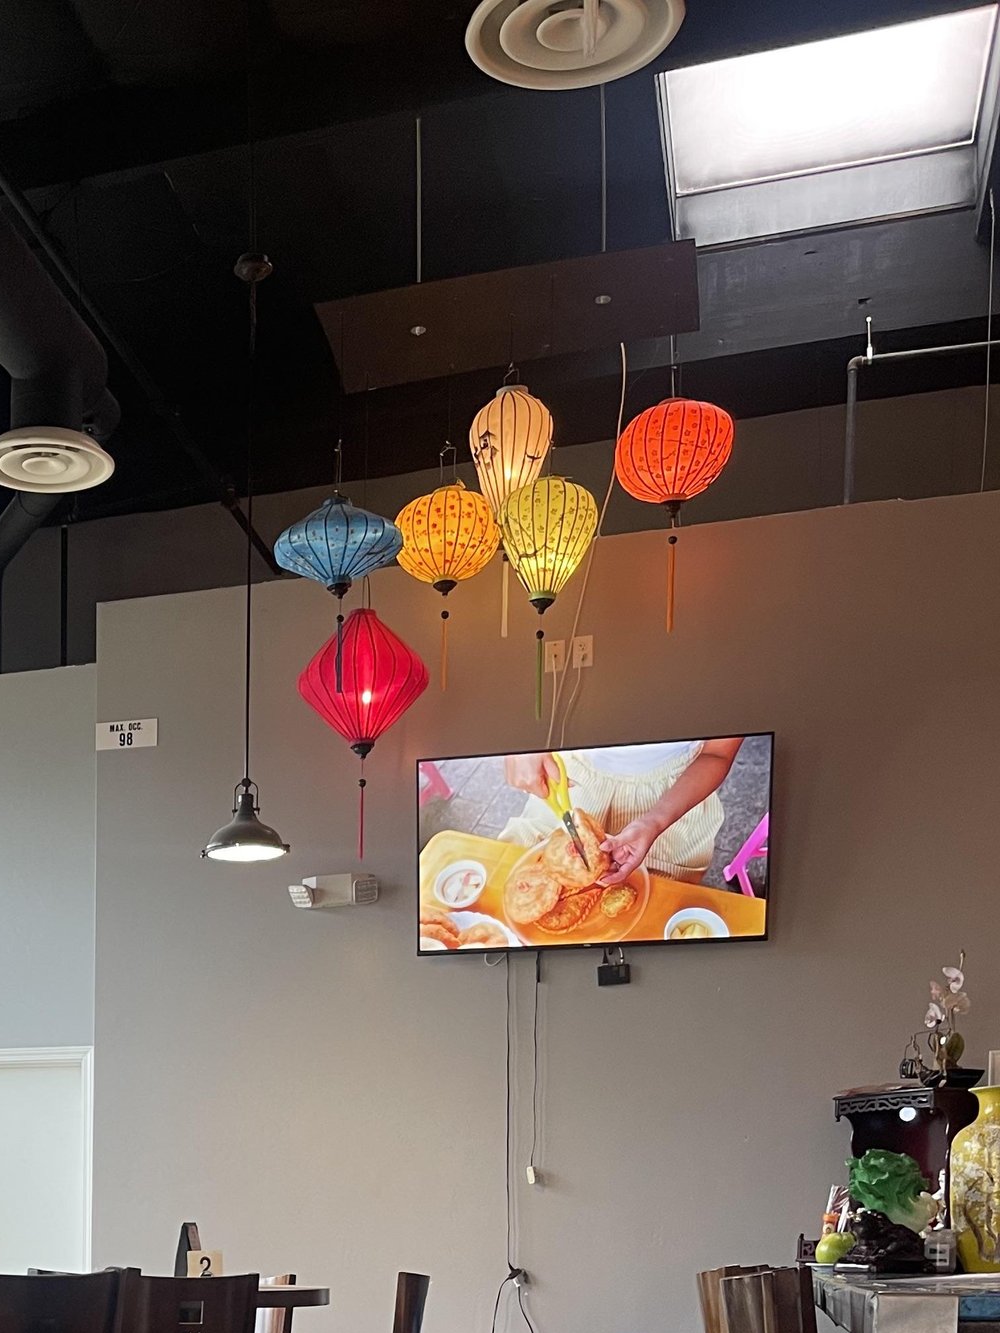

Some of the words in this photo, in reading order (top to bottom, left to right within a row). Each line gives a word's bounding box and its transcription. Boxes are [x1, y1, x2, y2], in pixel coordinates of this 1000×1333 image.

[109, 723, 126, 732] MAX.
[128, 722, 144, 731] OCC.
[119, 732, 133, 747] 98
[199, 1256, 212, 1277] 2
